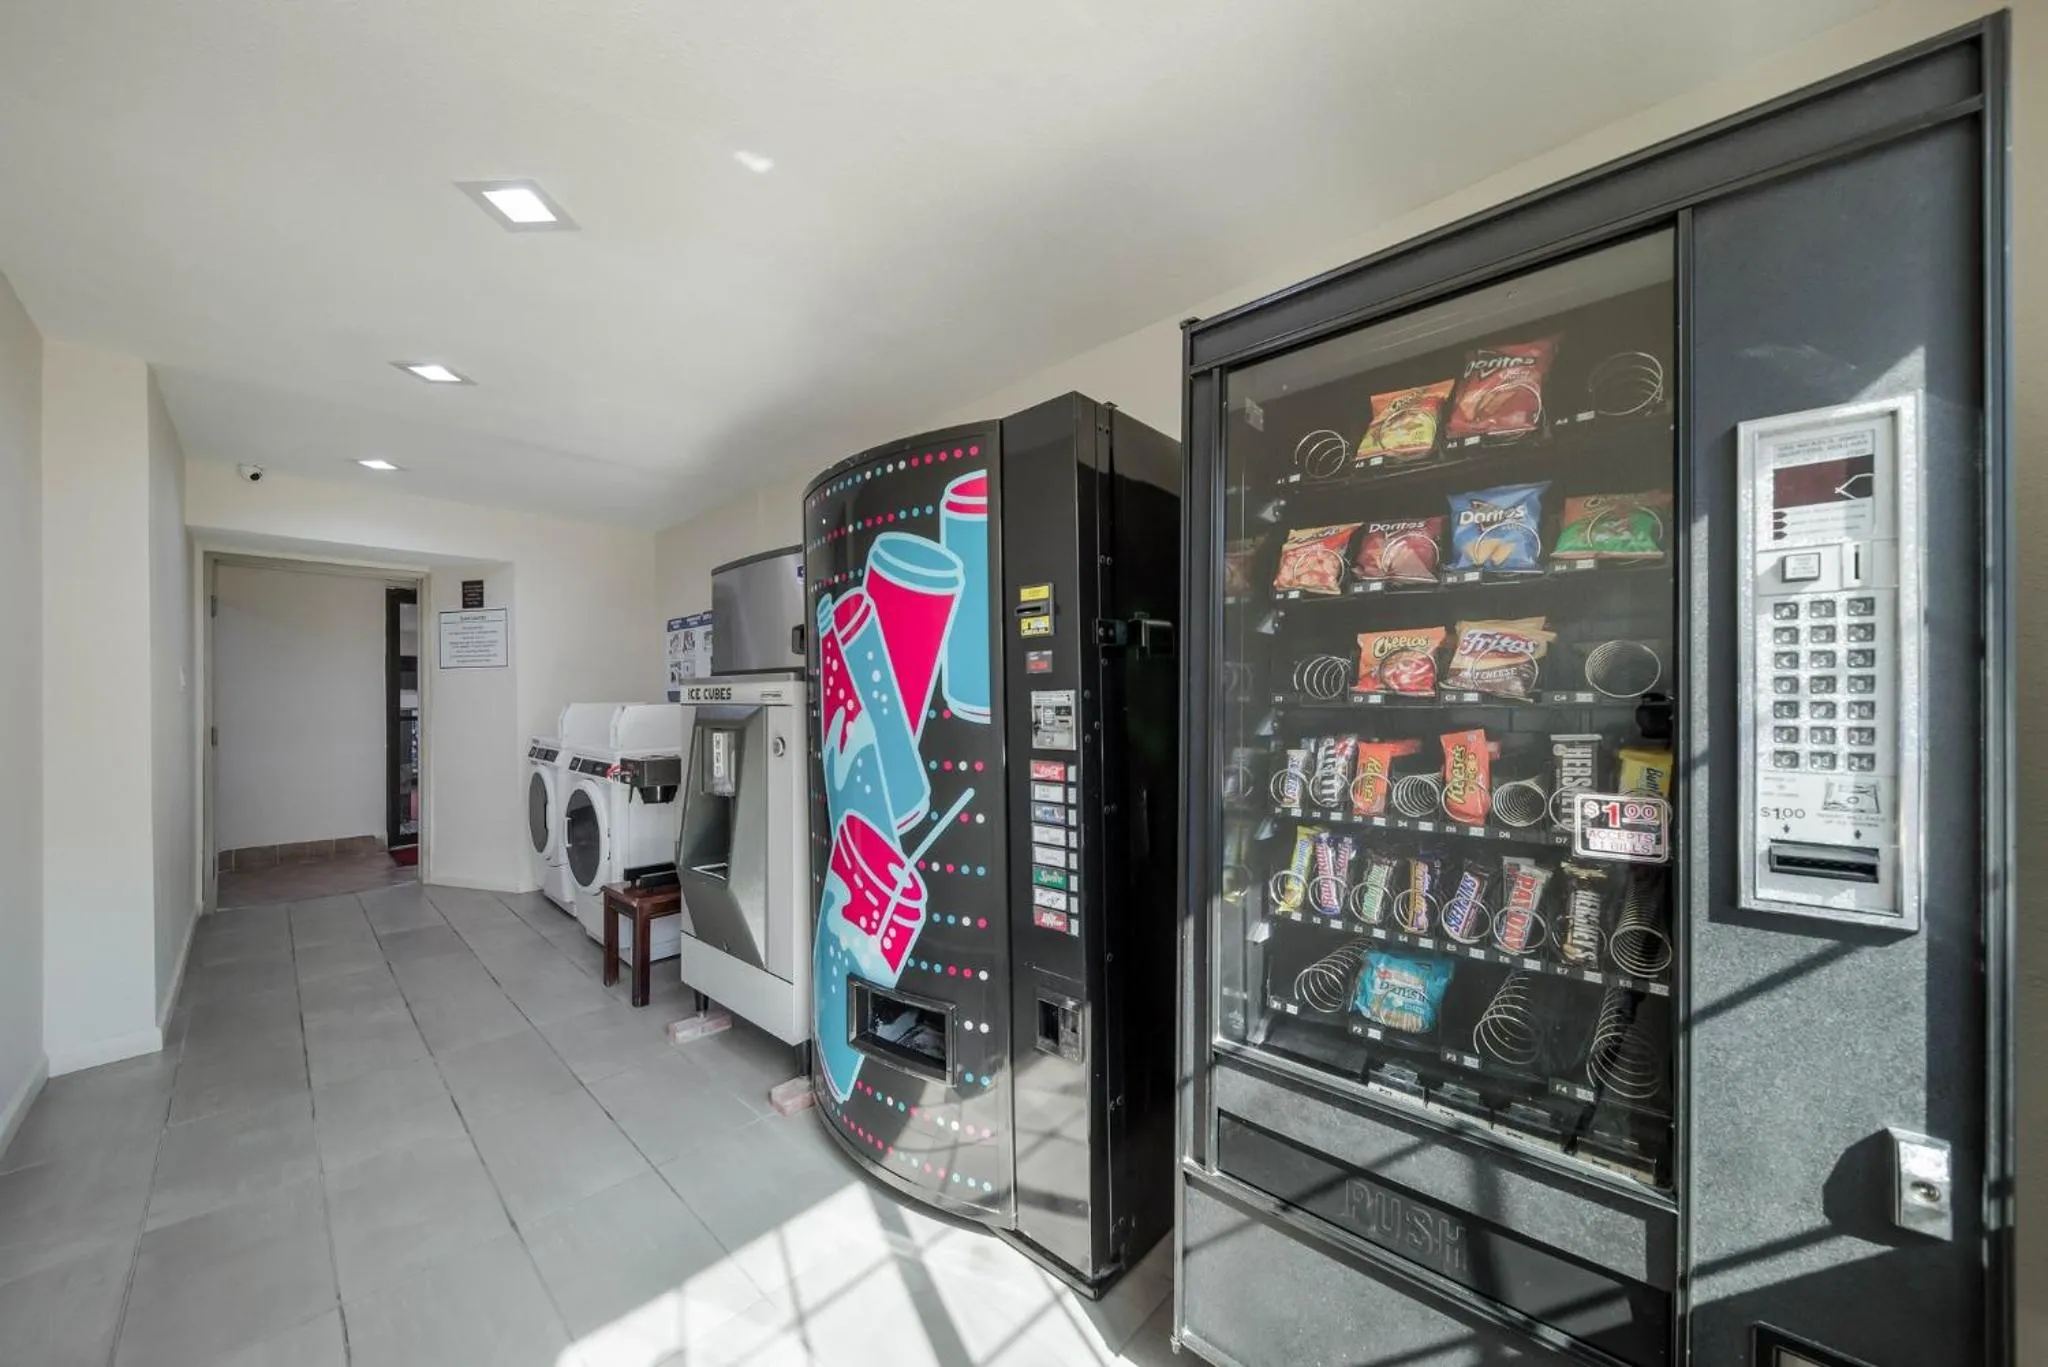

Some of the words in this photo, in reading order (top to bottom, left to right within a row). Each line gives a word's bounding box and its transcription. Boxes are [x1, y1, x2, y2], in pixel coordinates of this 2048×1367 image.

[1460, 504, 1526, 526] Doritos
[1369, 521, 1426, 534] Doritos
[1374, 636, 1428, 658] Cheetos
[1460, 630, 1539, 655] Fritos
[687, 687, 701, 701] ICE
[703, 687, 732, 701] CUBES
[1555, 836, 1567, 844] D7
[1588, 829, 1653, 844] ACCEPTS
[1447, 875, 1478, 934] SNICKERS
[1341, 1179, 1467, 1271] PUSH
